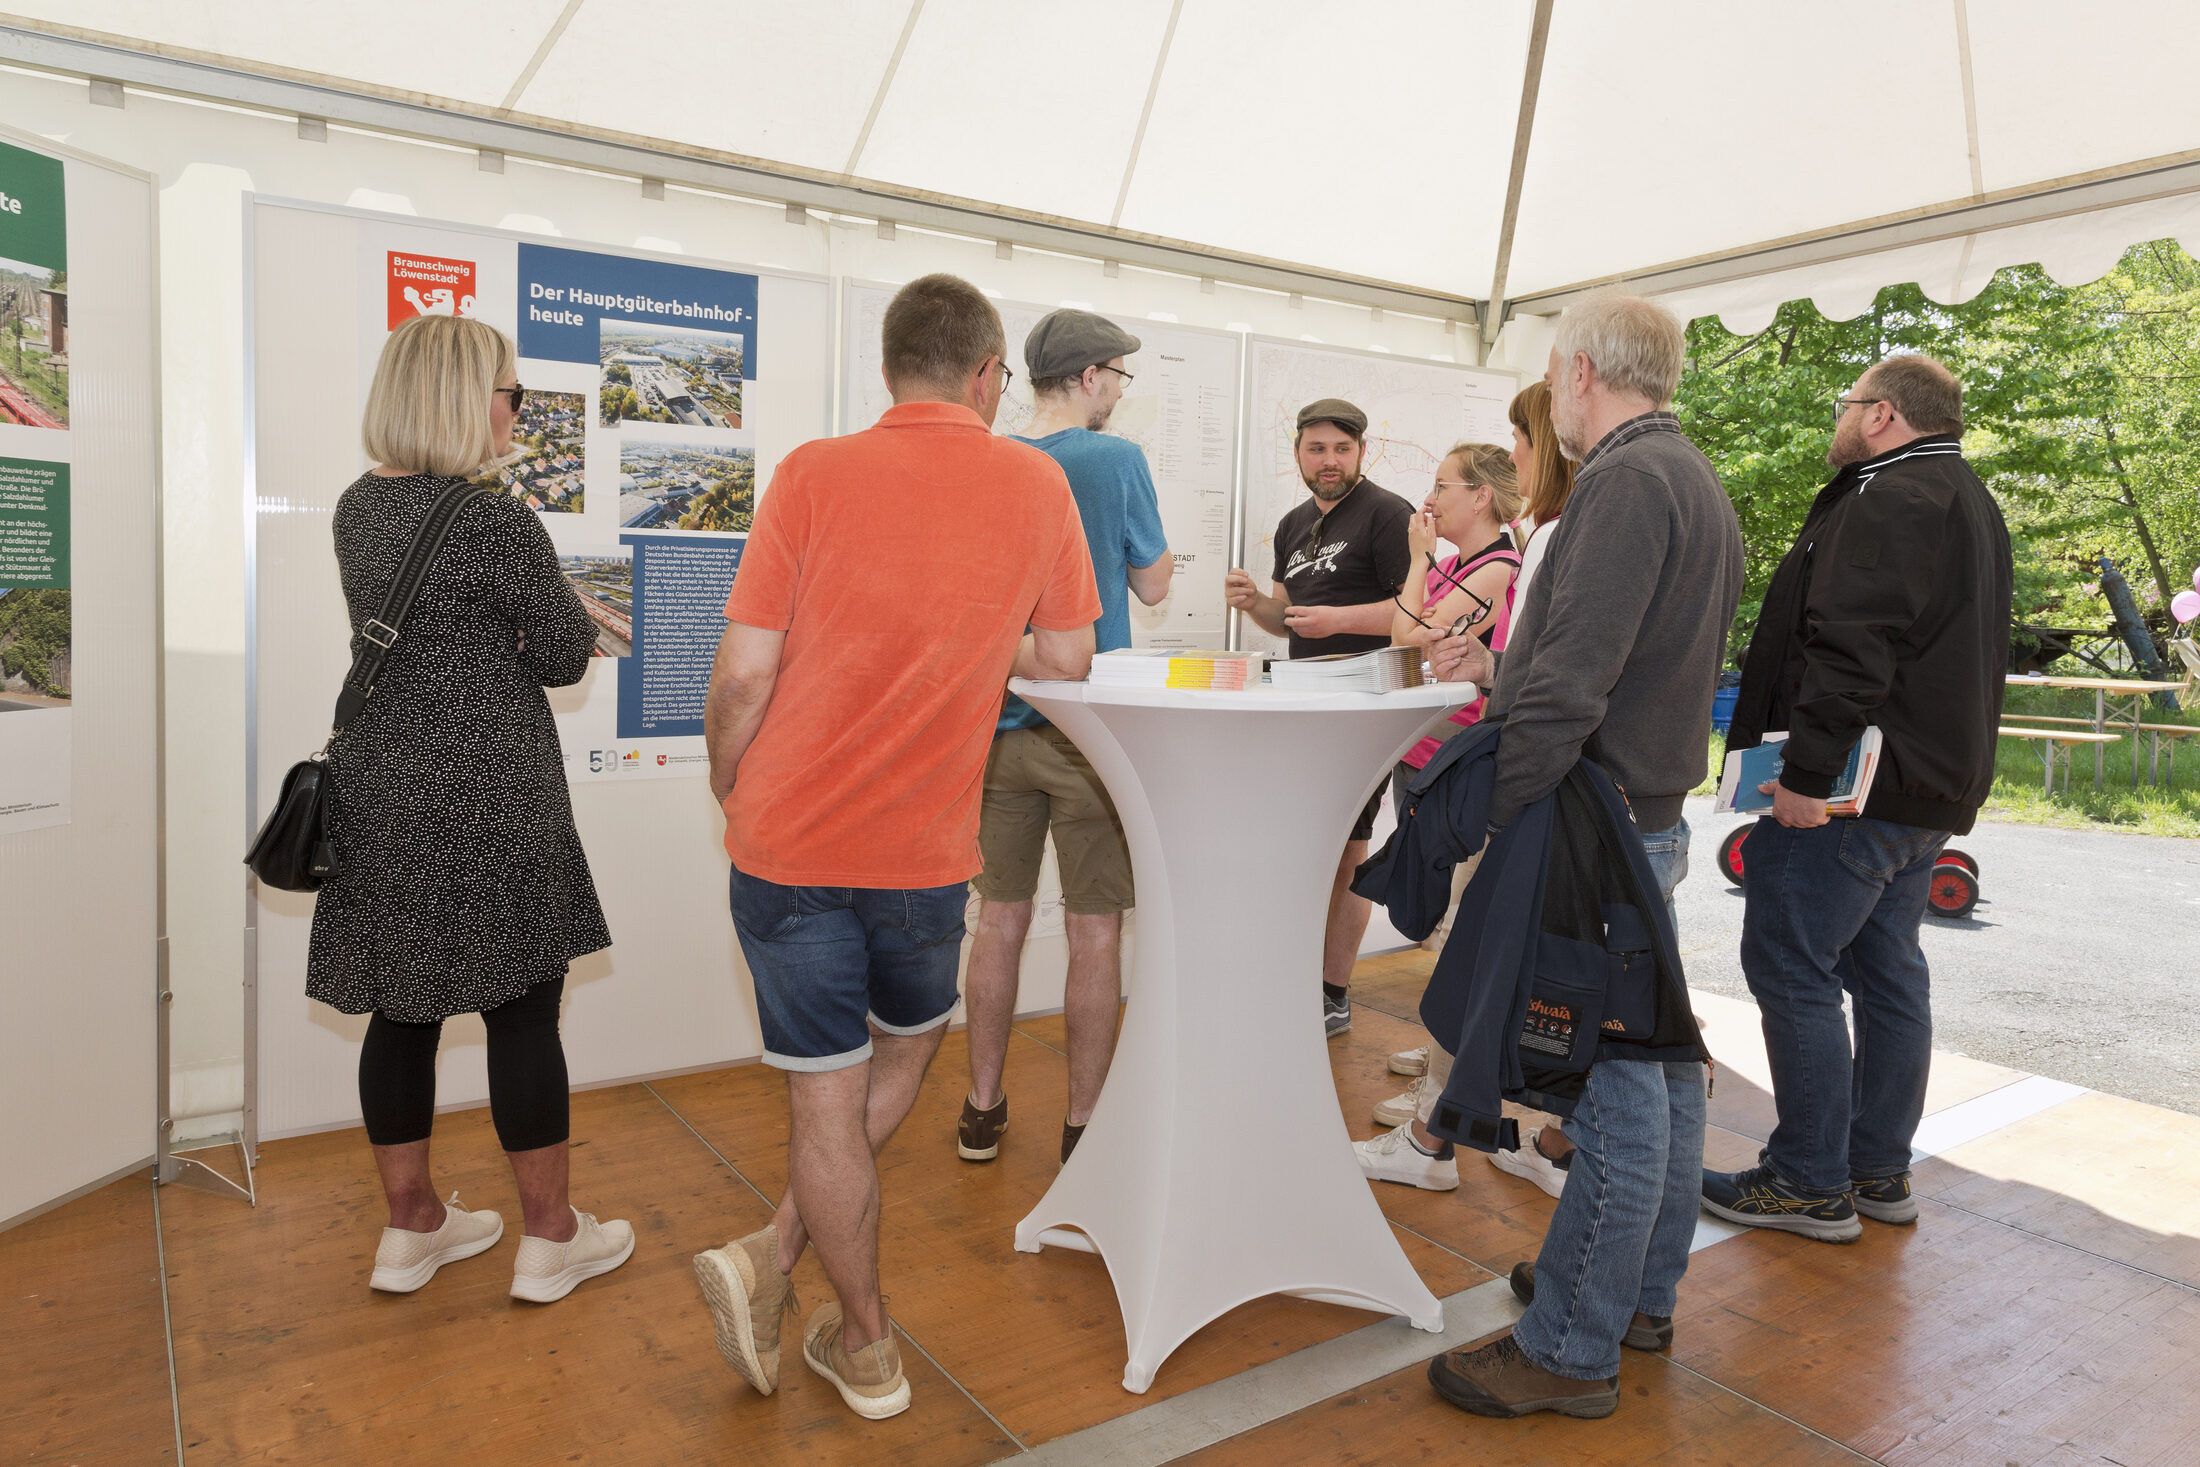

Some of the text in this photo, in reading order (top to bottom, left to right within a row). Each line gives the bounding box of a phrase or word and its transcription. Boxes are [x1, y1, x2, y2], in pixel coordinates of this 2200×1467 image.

[393, 256, 471, 277] Braunschweig
[393, 268, 459, 285] Löwenstadt
[530, 283, 564, 302] Der
[569, 287, 742, 323] Hauptgüterbahnhof
[529, 305, 584, 327] heute
[0, 466, 33, 476] bauwerke
[3, 493, 45, 502] Salzdahlumer
[18, 503, 48, 511] Denkmal-
[20, 529, 38, 537] bildet
[2, 546, 35, 554] Besonders
[1172, 554, 1195, 562] STADT
[5, 563, 41, 571] Stützmauer
[589, 749, 618, 773] 50
